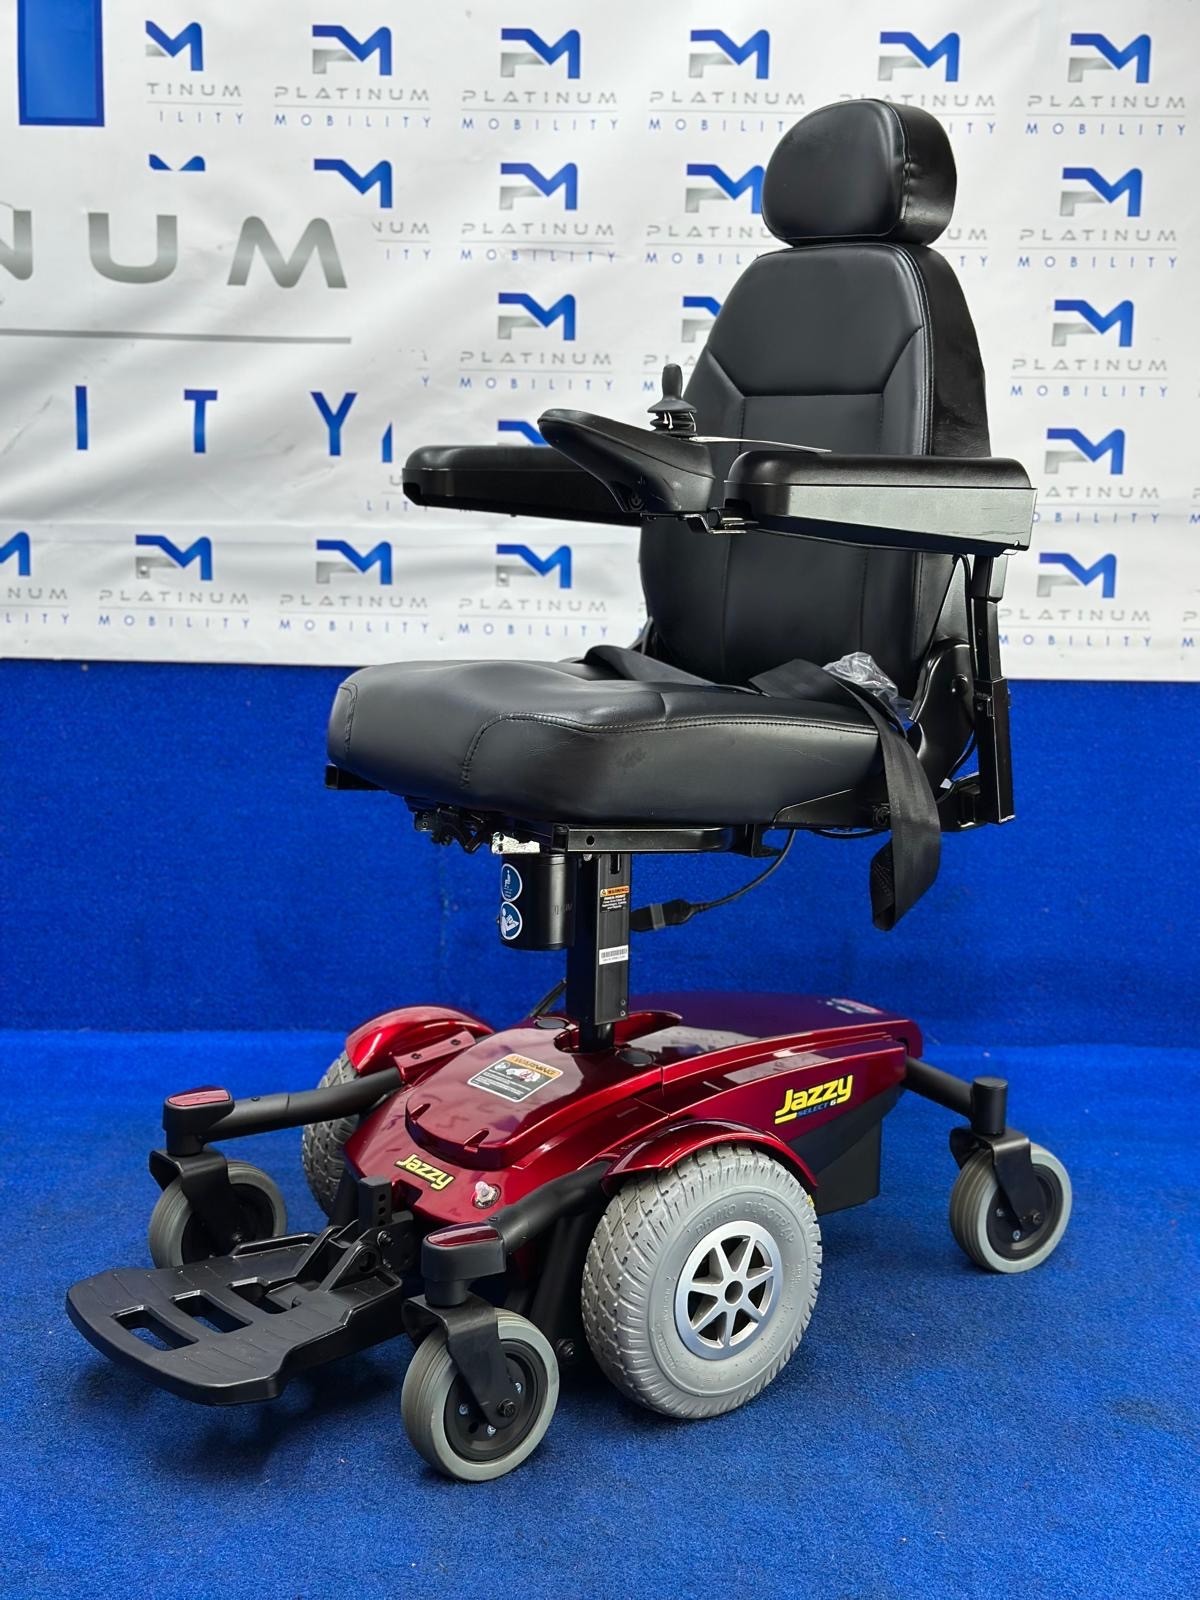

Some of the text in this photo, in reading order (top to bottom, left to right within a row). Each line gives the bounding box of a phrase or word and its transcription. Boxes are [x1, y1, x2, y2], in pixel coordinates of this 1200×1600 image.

[274, 86, 429, 101] PLATINUM
[462, 90, 616, 104] PLATINUM
[650, 91, 805, 105] PLATINUM
[1028, 95, 1186, 109] PLATINUM
[274, 114, 431, 128] MOBILITY
[461, 117, 617, 131] MOBILITY
[1026, 123, 1186, 136] MOBILITY
[462, 223, 614, 236] PLATINUM
[1020, 229, 1176, 241] PLATINUM
[460, 248, 616, 262] MOBILITY
[1017, 256, 1177, 268] MOBILITY
[459, 351, 611, 365] PLATINUM
[1012, 359, 1167, 371] PLATINUM
[459, 375, 613, 390] MOBILITY
[1010, 385, 1168, 397] MOBILITY
[99, 589, 248, 606] PLATINUM
[280, 593, 427, 607] PLATINUM
[459, 598, 606, 612] PLATINUM
[98, 614, 249, 628] MOBILITY
[999, 608, 1150, 622] PLATINUM
[279, 619, 429, 633] MOBILITY
[457, 624, 608, 637] MOBILITY
[998, 634, 1152, 647] MOBILITY
[775, 1074, 853, 1117] Jazzy
[796, 1102, 829, 1117] SELECT
[396, 1153, 455, 1191] Jazzy
